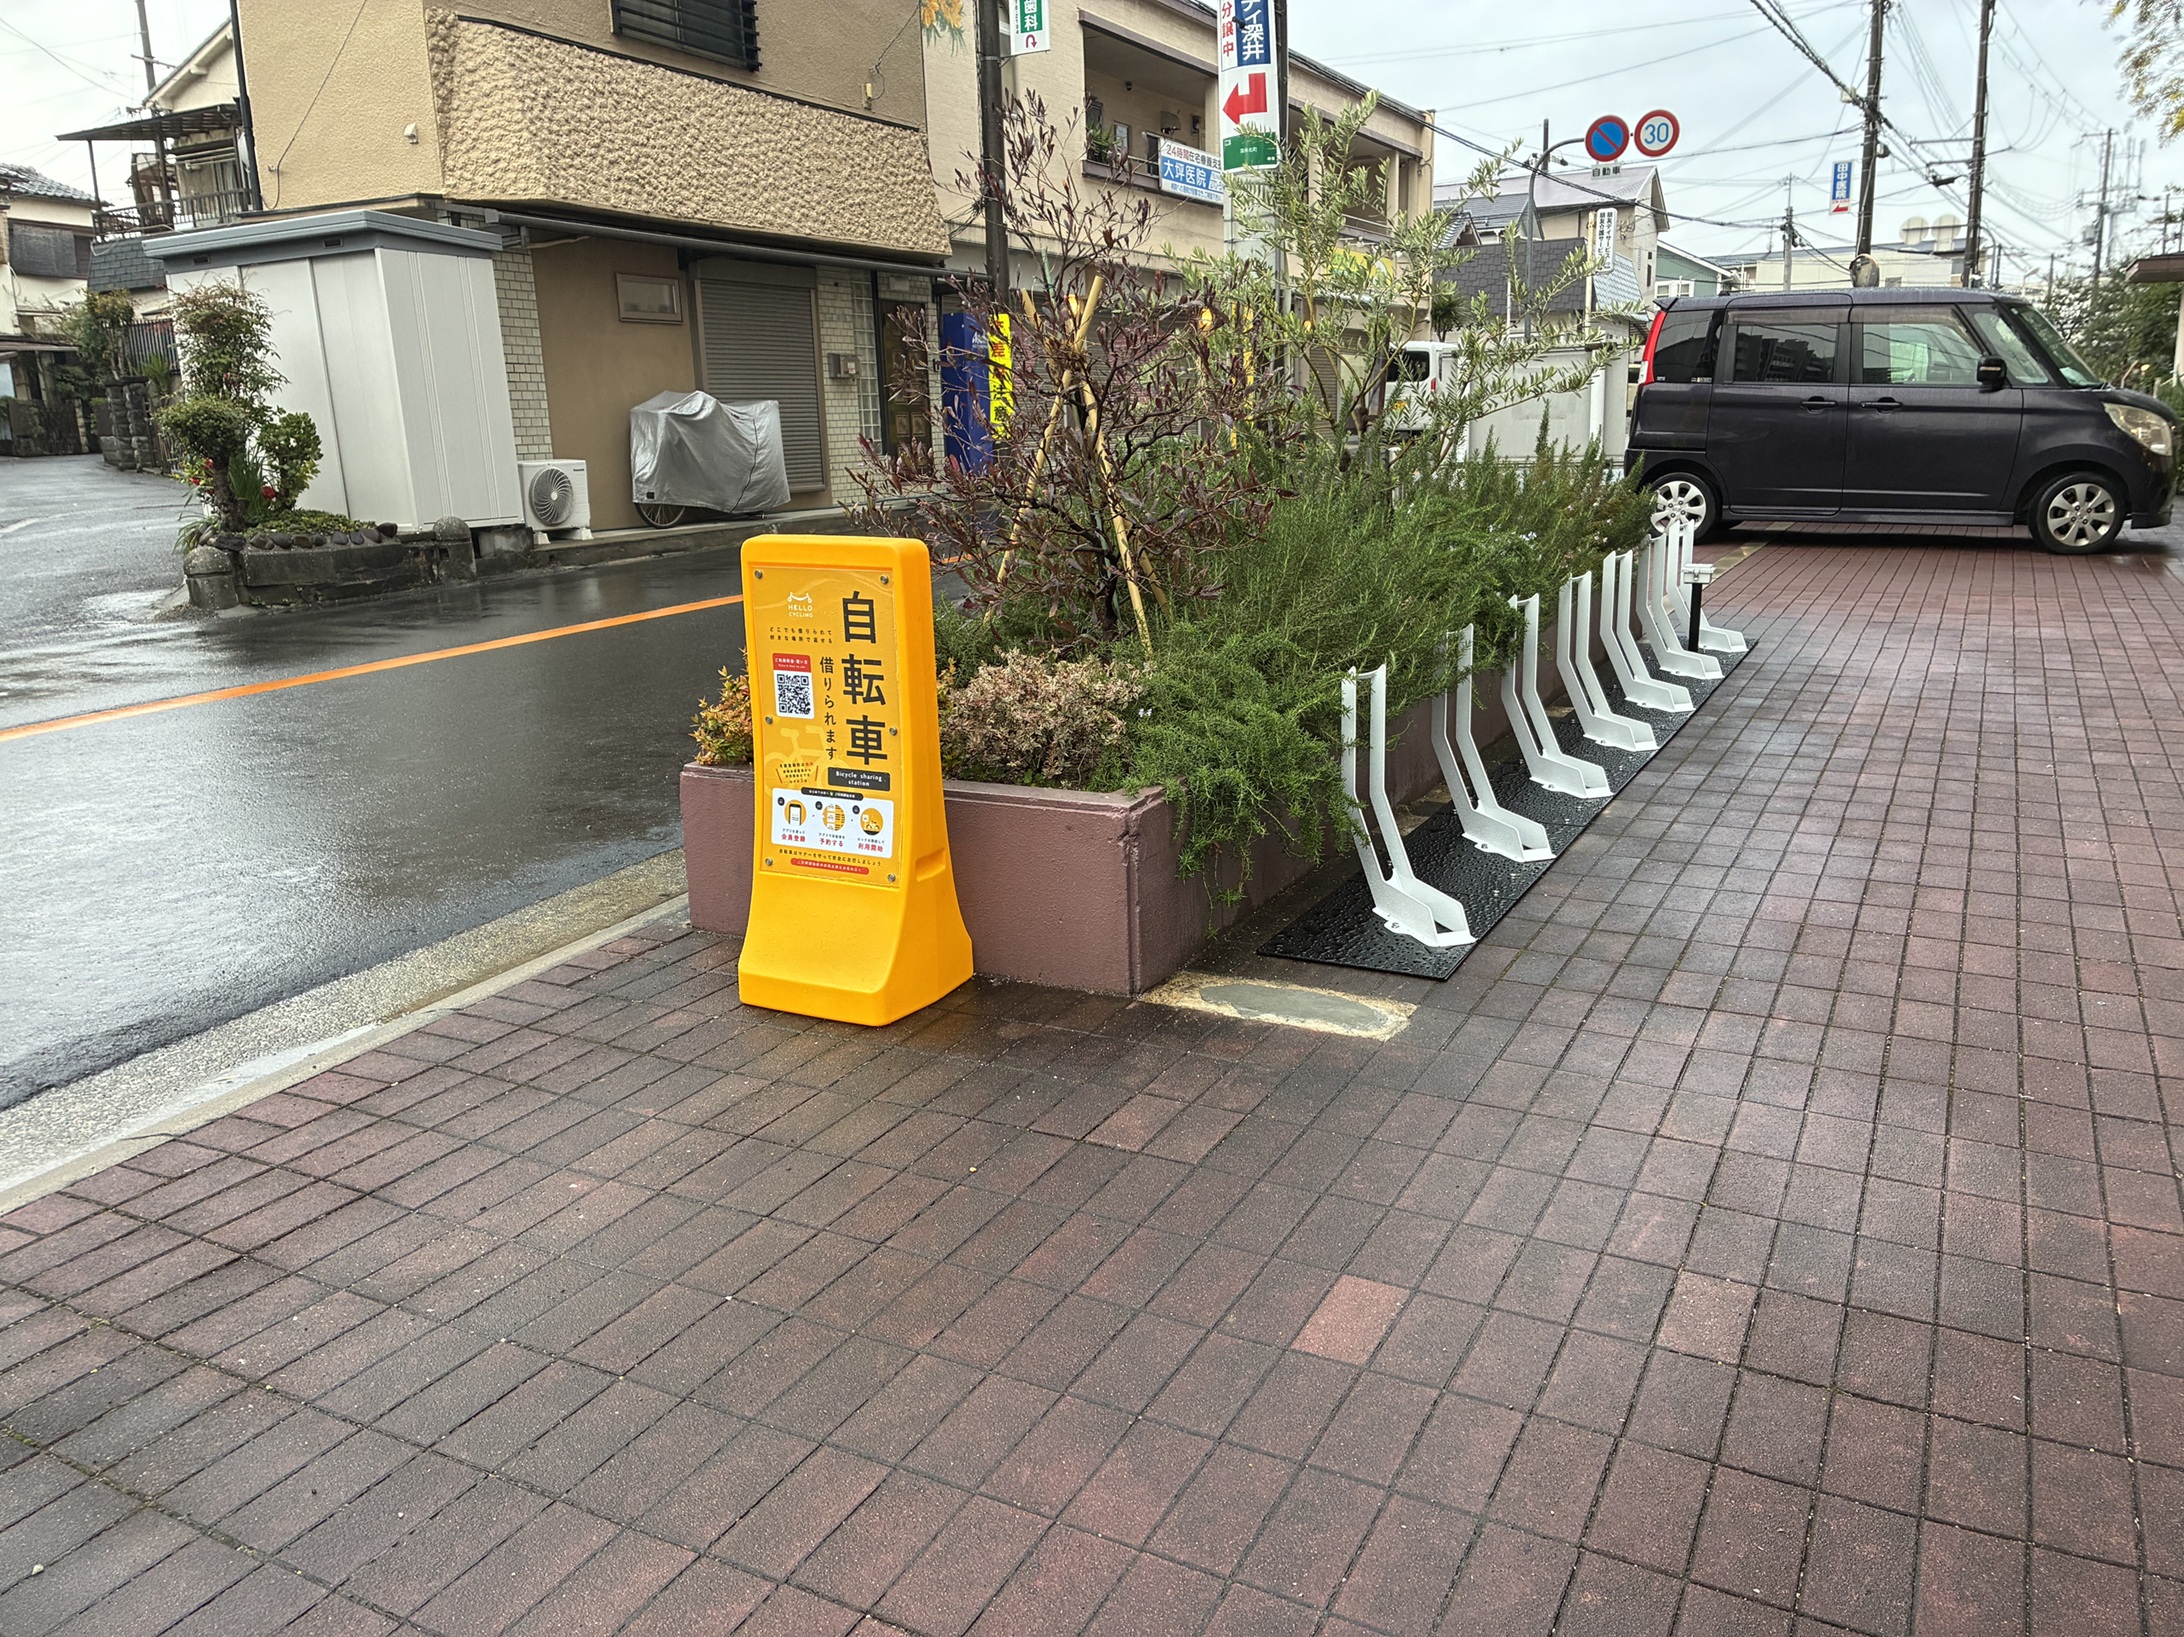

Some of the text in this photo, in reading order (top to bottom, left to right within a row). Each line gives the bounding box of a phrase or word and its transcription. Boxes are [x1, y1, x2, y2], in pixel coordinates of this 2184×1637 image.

[1222, 1, 1234, 57] 分譲中
[1644, 122, 1669, 144] 30
[1163, 160, 1207, 188] 大坪医院
[1592, 166, 1621, 177] 自動車
[1835, 163, 1849, 199] 田中医院
[769, 626, 832, 635] どこでも借りられて
[769, 635, 833, 644] 好きな場所で返せる
[841, 590, 888, 766] 自転車
[820, 656, 837, 760] 借りられます
[836, 771, 882, 782] Bicycle sharing
[848, 779, 870, 787] station
[781, 834, 806, 842] 会員登録
[820, 838, 844, 848] 予約する
[857, 843, 884, 852] 利用開始
